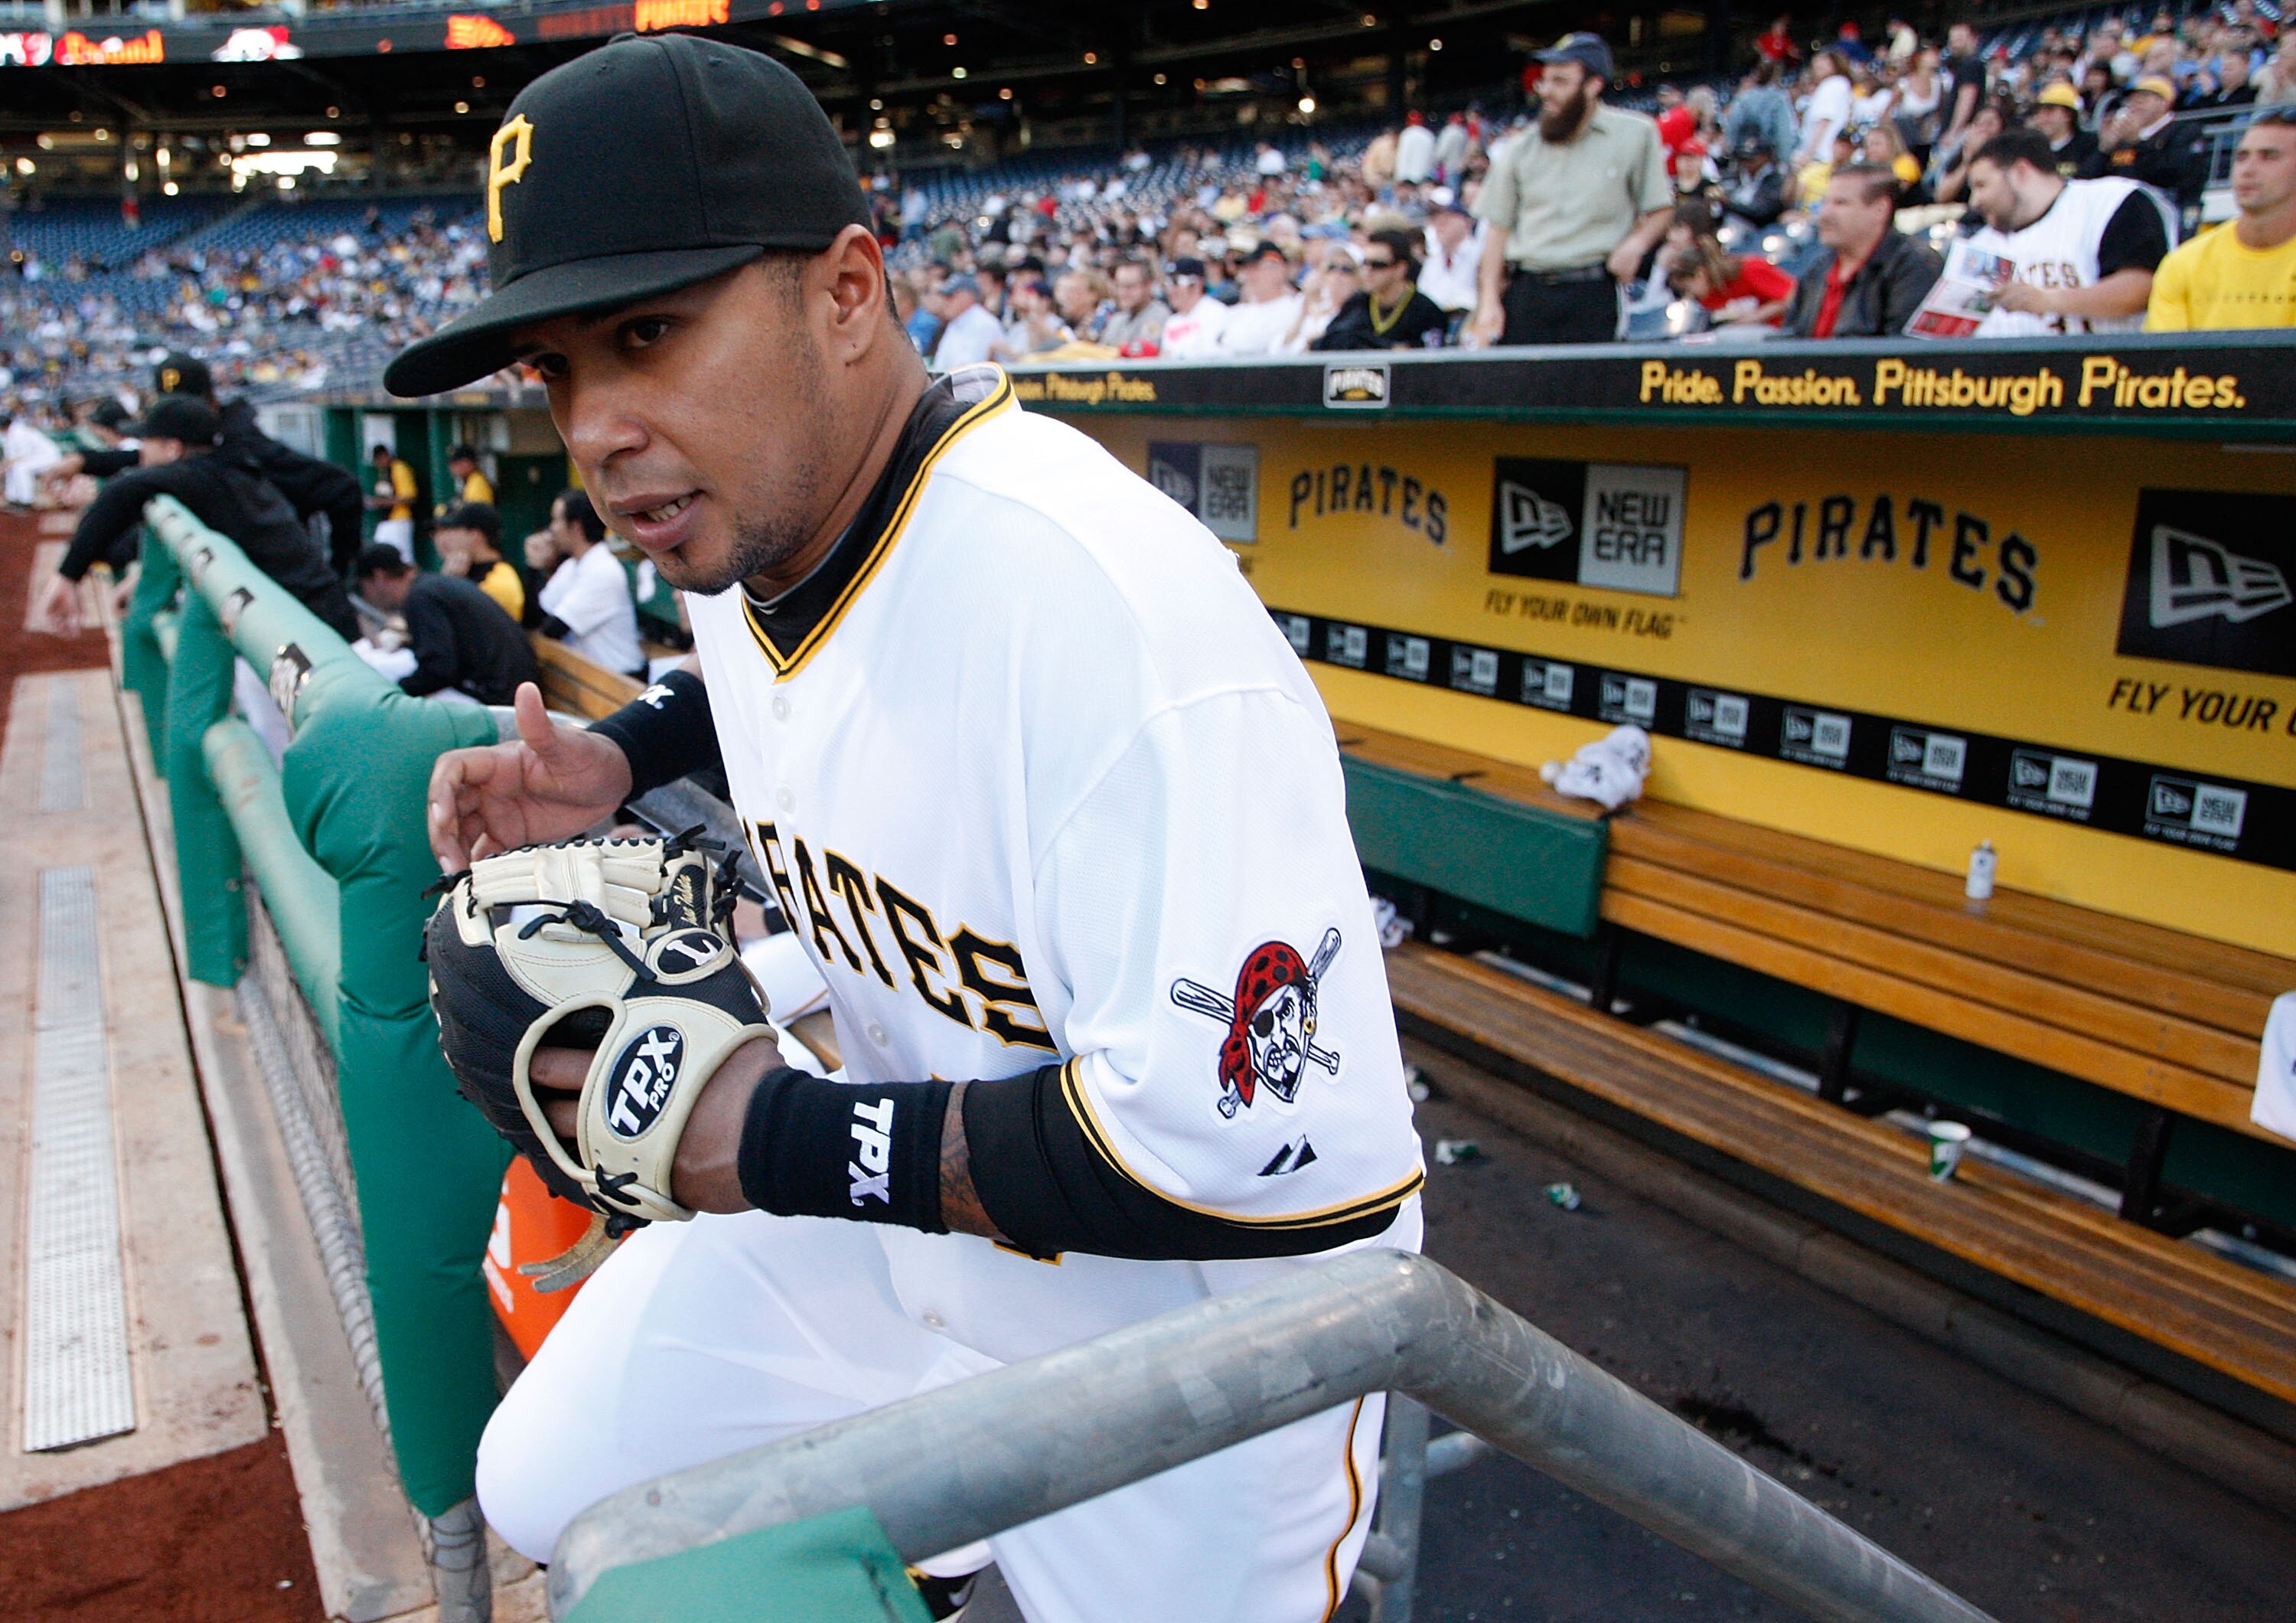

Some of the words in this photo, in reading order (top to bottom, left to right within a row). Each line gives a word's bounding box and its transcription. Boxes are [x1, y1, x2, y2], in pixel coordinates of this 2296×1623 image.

[488, 113, 534, 245] P
[1639, 360, 1724, 403] Pride.
[1732, 359, 1862, 406] Passion.
[1873, 358, 2063, 416] Pittsburgh
[2077, 355, 2247, 409] Pirates.
[1289, 464, 1446, 546] PIRATES
[1596, 489, 1668, 528] NEW
[1594, 527, 1667, 568] ERA
[1739, 494, 2038, 614] PIRATES
[1486, 589, 1514, 615] FLY
[1518, 593, 1569, 622] YOUR
[1571, 601, 1619, 632] OWN
[1621, 609, 1675, 640] FLAG
[2108, 678, 2169, 714] FLY
[2180, 688, 2278, 733] YOUR
[666, 939, 719, 966] L
[610, 1029, 677, 1134] TPX
[649, 1063, 675, 1112] PRO
[848, 1098, 895, 1204] TPX
